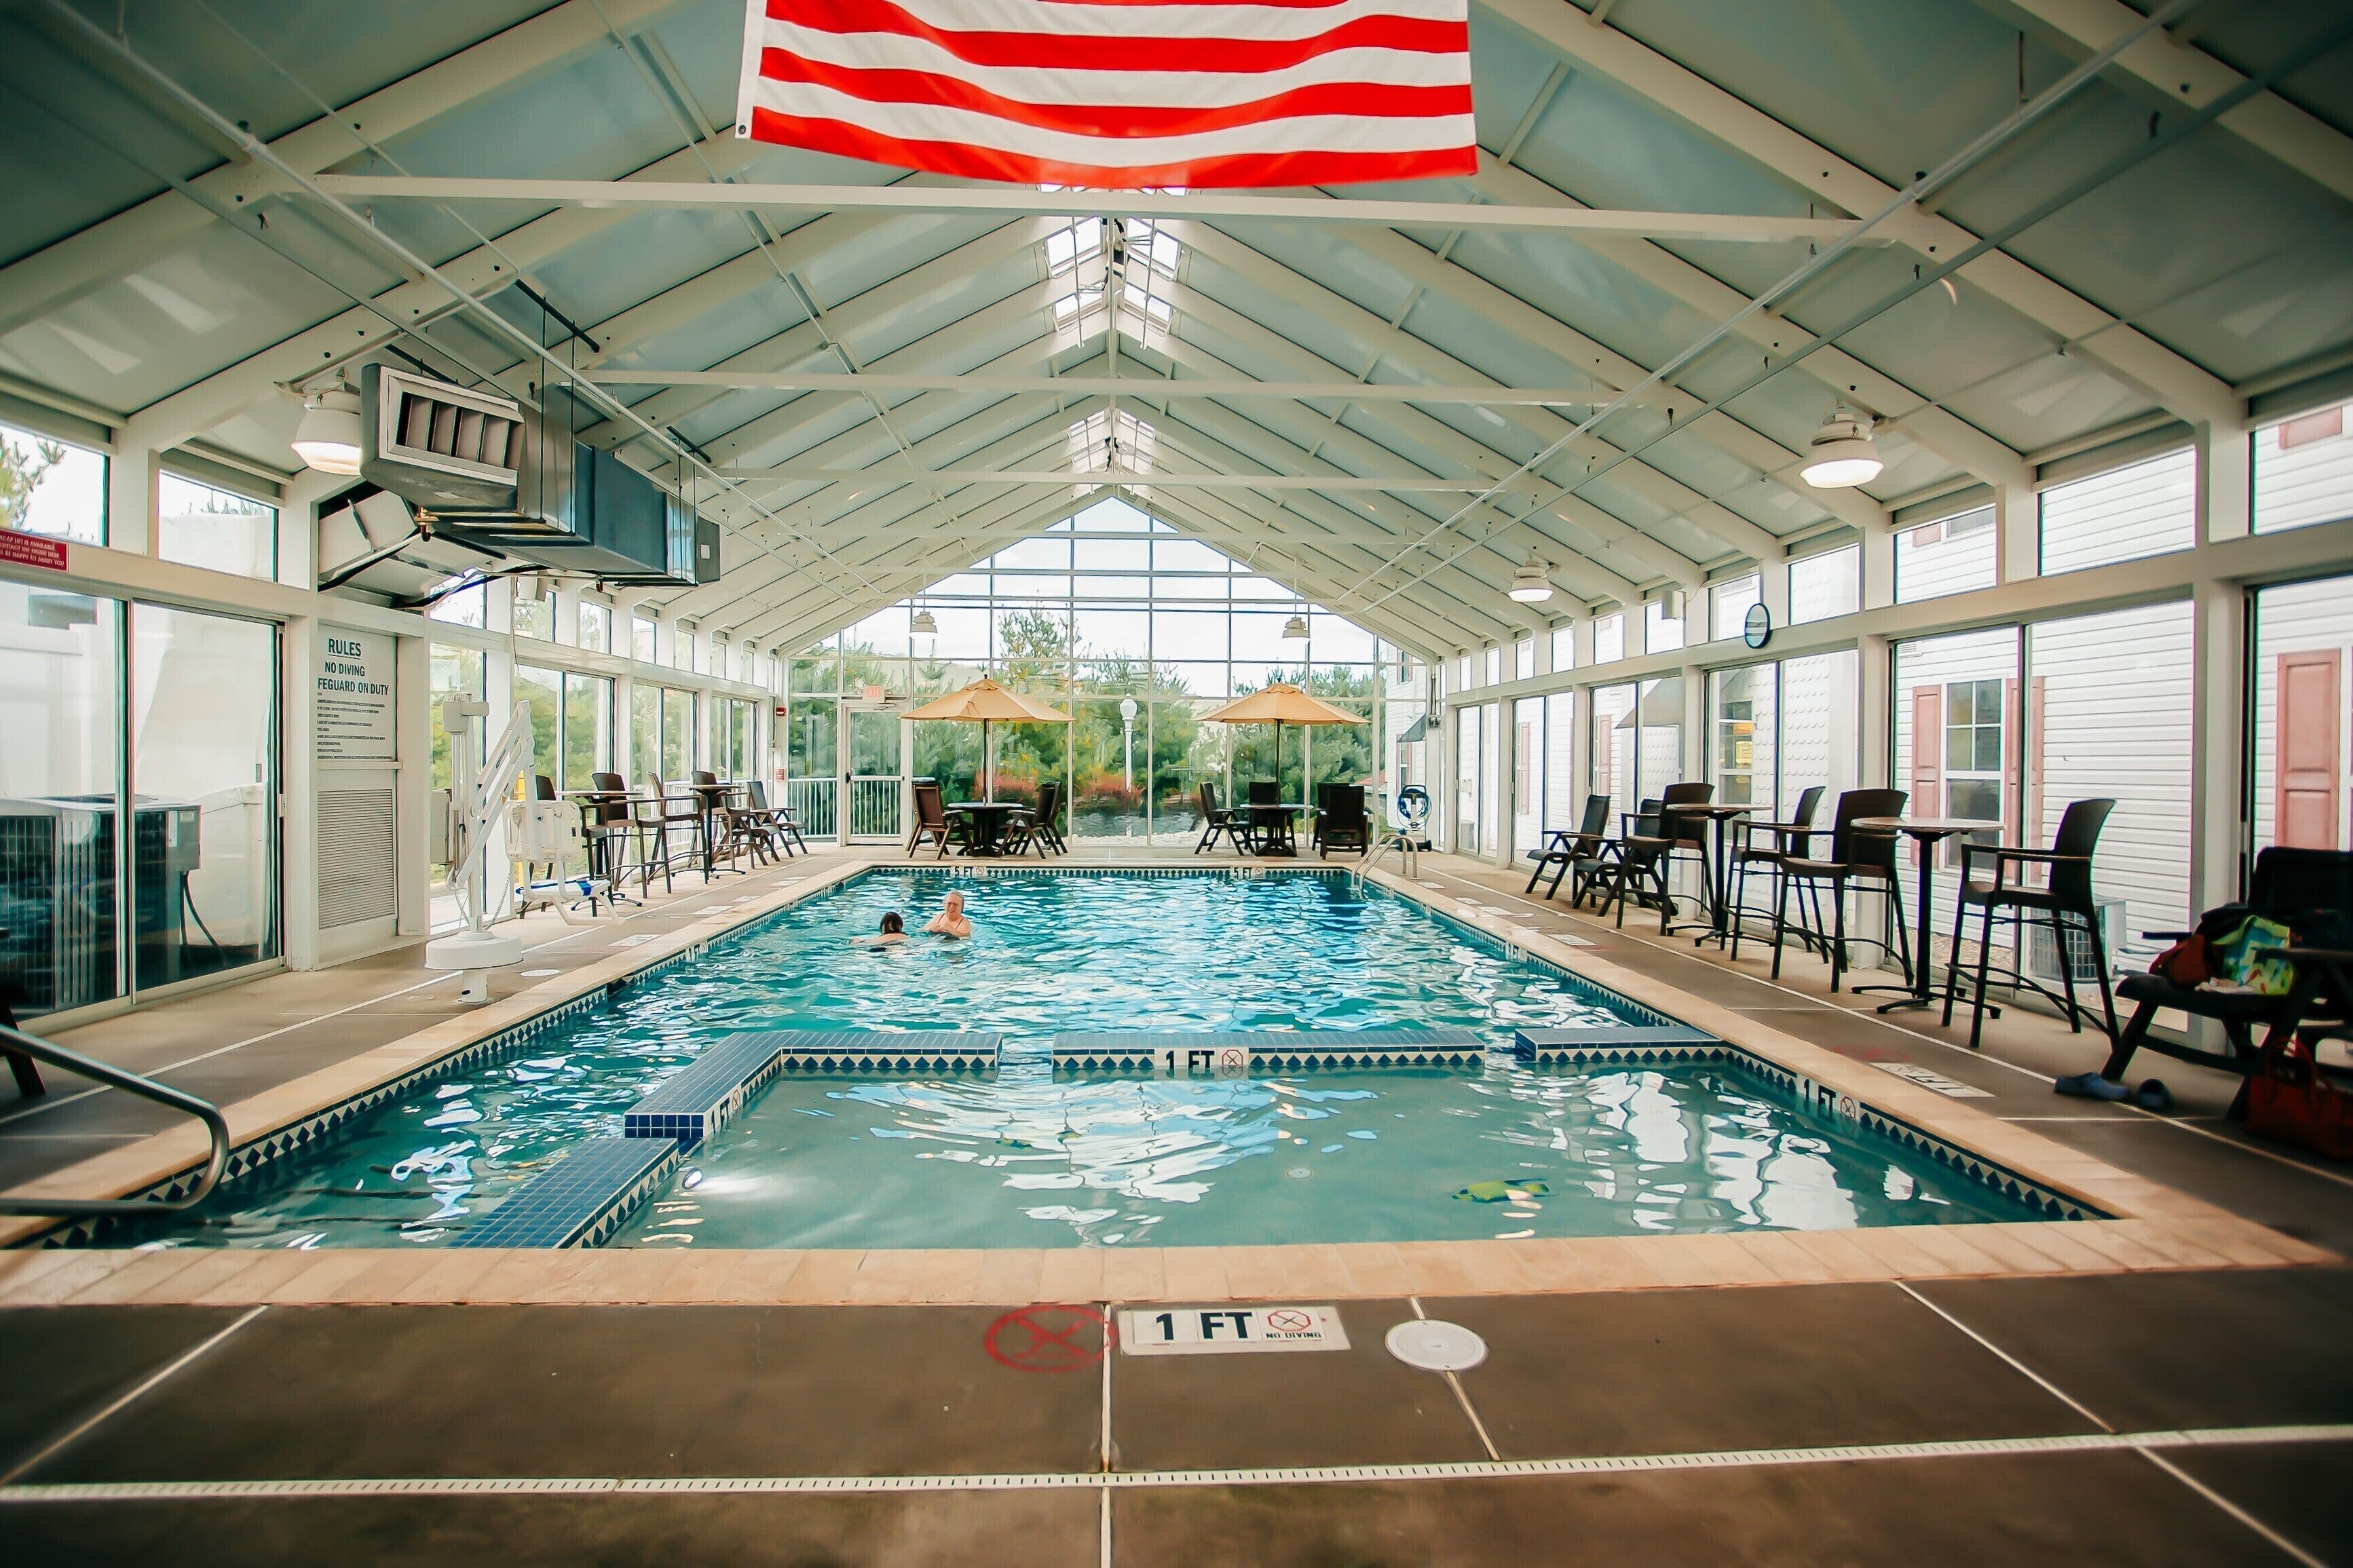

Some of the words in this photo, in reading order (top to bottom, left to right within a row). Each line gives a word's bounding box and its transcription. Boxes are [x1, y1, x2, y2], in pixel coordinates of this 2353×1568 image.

[328, 638, 362, 657] RULES
[324, 662, 337, 674] NO
[339, 663, 365, 677] DIVING
[318, 678, 356, 692] FEGUARD
[358, 682, 369, 693] ON
[371, 683, 390, 695] DUTY
[963, 866, 974, 878] FT
[1242, 867, 1253, 879] FT
[1165, 1050, 1175, 1069] 1
[1188, 1050, 1215, 1069] FT
[1818, 1084, 1837, 1111] FT
[719, 1098, 730, 1129] FT
[1156, 1313, 1174, 1341] 1
[1200, 1312, 1253, 1339] FT
